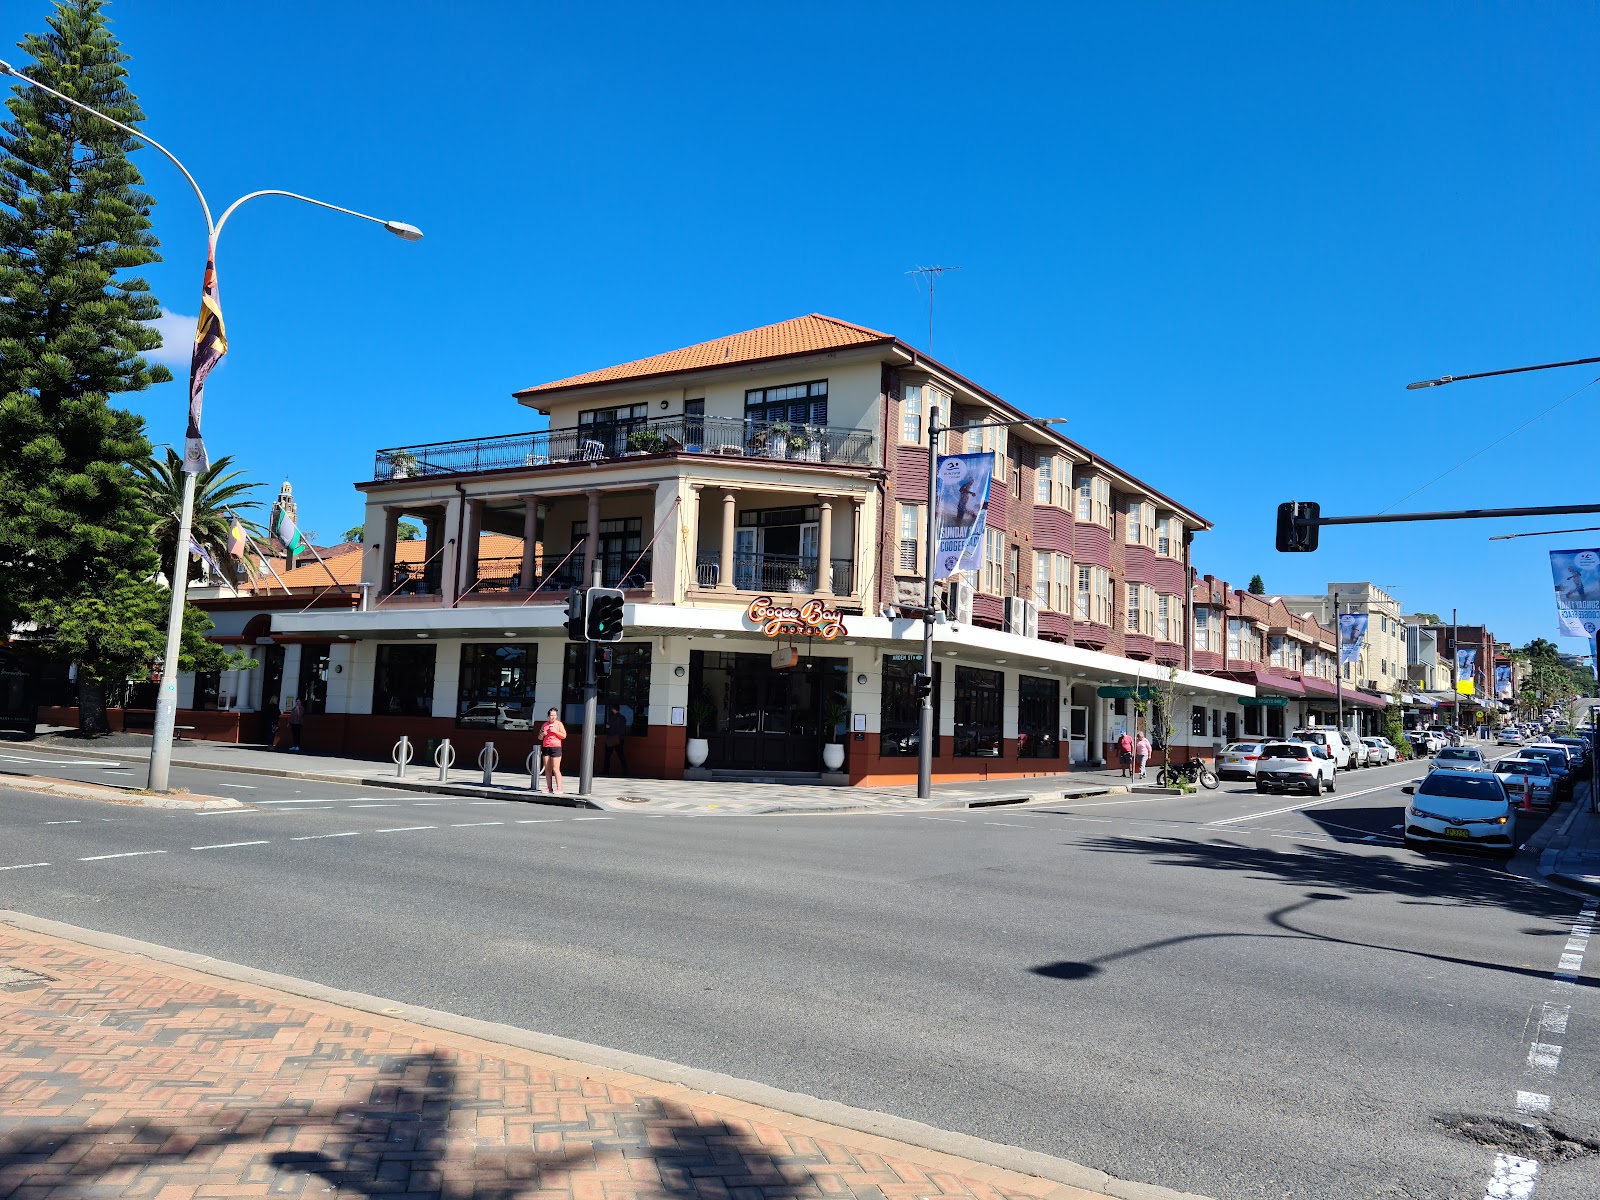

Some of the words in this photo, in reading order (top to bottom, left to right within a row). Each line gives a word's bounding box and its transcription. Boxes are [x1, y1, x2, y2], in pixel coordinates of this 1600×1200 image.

[941, 526, 967, 538] SUNDAY
[941, 540, 965, 552] COOGEE
[748, 597, 806, 637] Coogee
[801, 599, 847, 639] Bay
[780, 626, 821, 635] HOTEL
